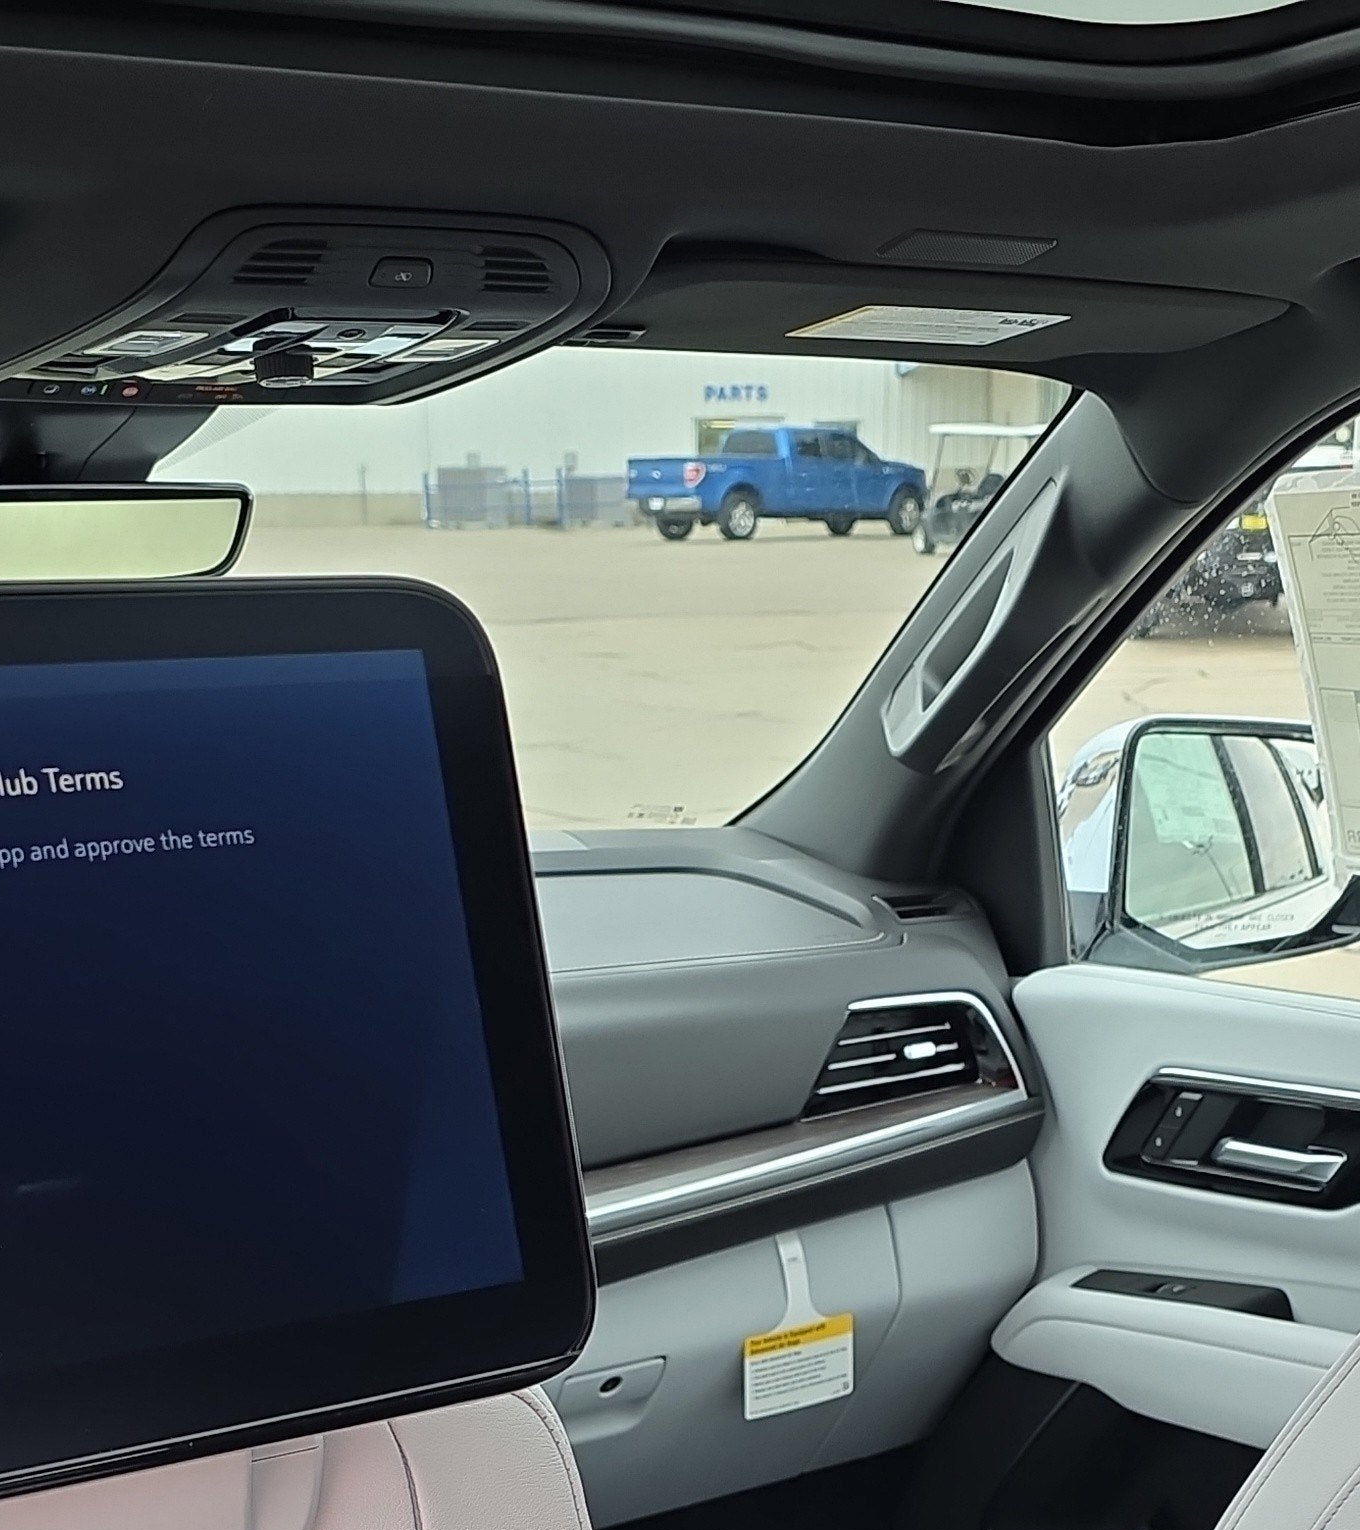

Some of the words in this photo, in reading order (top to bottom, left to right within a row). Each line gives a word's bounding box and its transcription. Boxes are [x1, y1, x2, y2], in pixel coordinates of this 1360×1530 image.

[704, 385, 768, 402] PARTS
[40, 767, 124, 794] Terms
[30, 838, 70, 862] and
[73, 836, 156, 862] approve
[159, 829, 193, 850] the
[197, 827, 255, 848] terms
